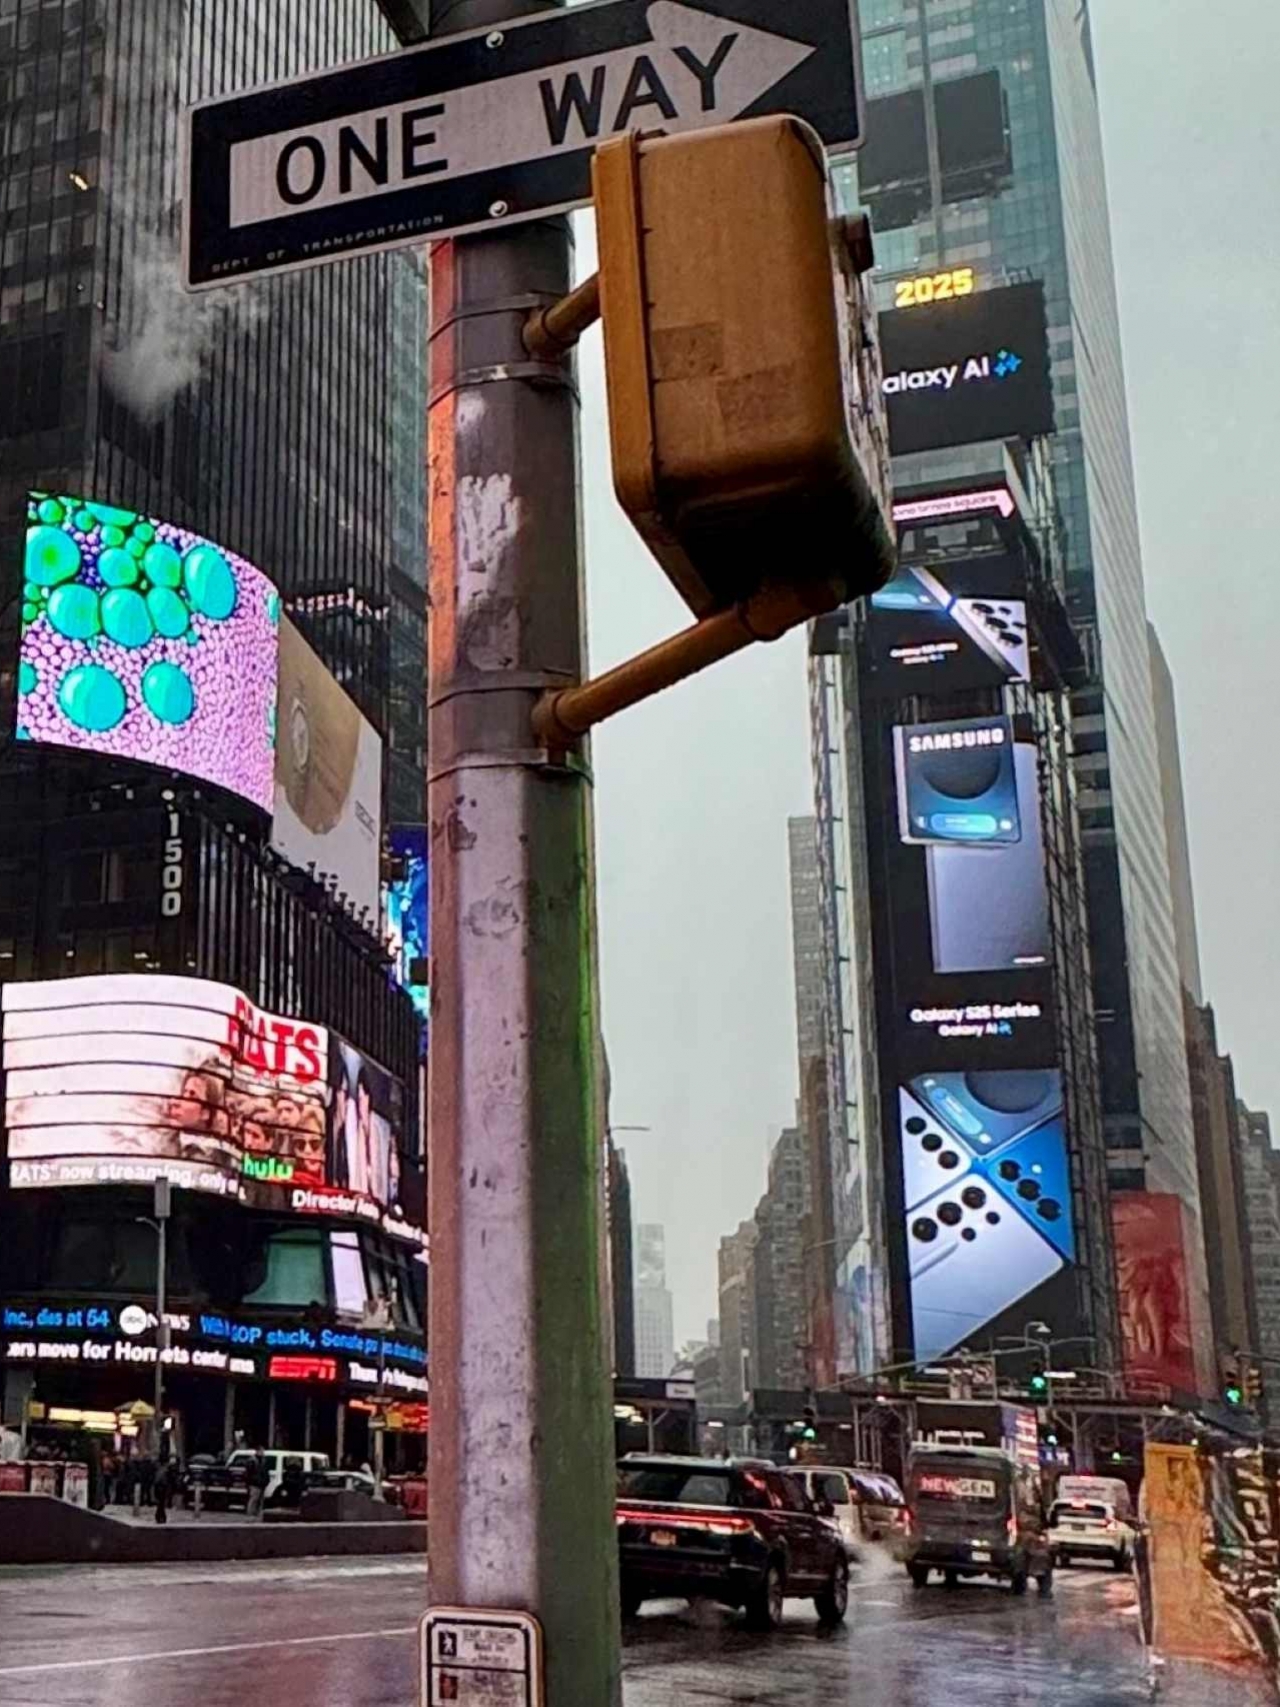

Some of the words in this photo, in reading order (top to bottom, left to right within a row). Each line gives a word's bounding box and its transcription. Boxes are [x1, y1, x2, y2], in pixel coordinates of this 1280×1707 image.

[274, 103, 449, 206] ONE
[536, 33, 740, 146] WAY
[302, 215, 445, 254] TRANSPORTATION
[895, 268, 974, 309] 2025
[882, 362, 959, 395] alaxy
[963, 355, 990, 382] AI
[909, 728, 1005, 752] SAMSUNG
[161, 812, 183, 917] 1500
[910, 1007, 963, 1023] Galaxy
[992, 1002, 1041, 1018] Series
[60, 1164, 96, 1180] now
[242, 1152, 294, 1180] hulu
[292, 1188, 357, 1213] Director
[147, 1313, 191, 1331] NWS
[82, 1340, 111, 1359] for
[270, 1356, 337, 1380] ESPN
